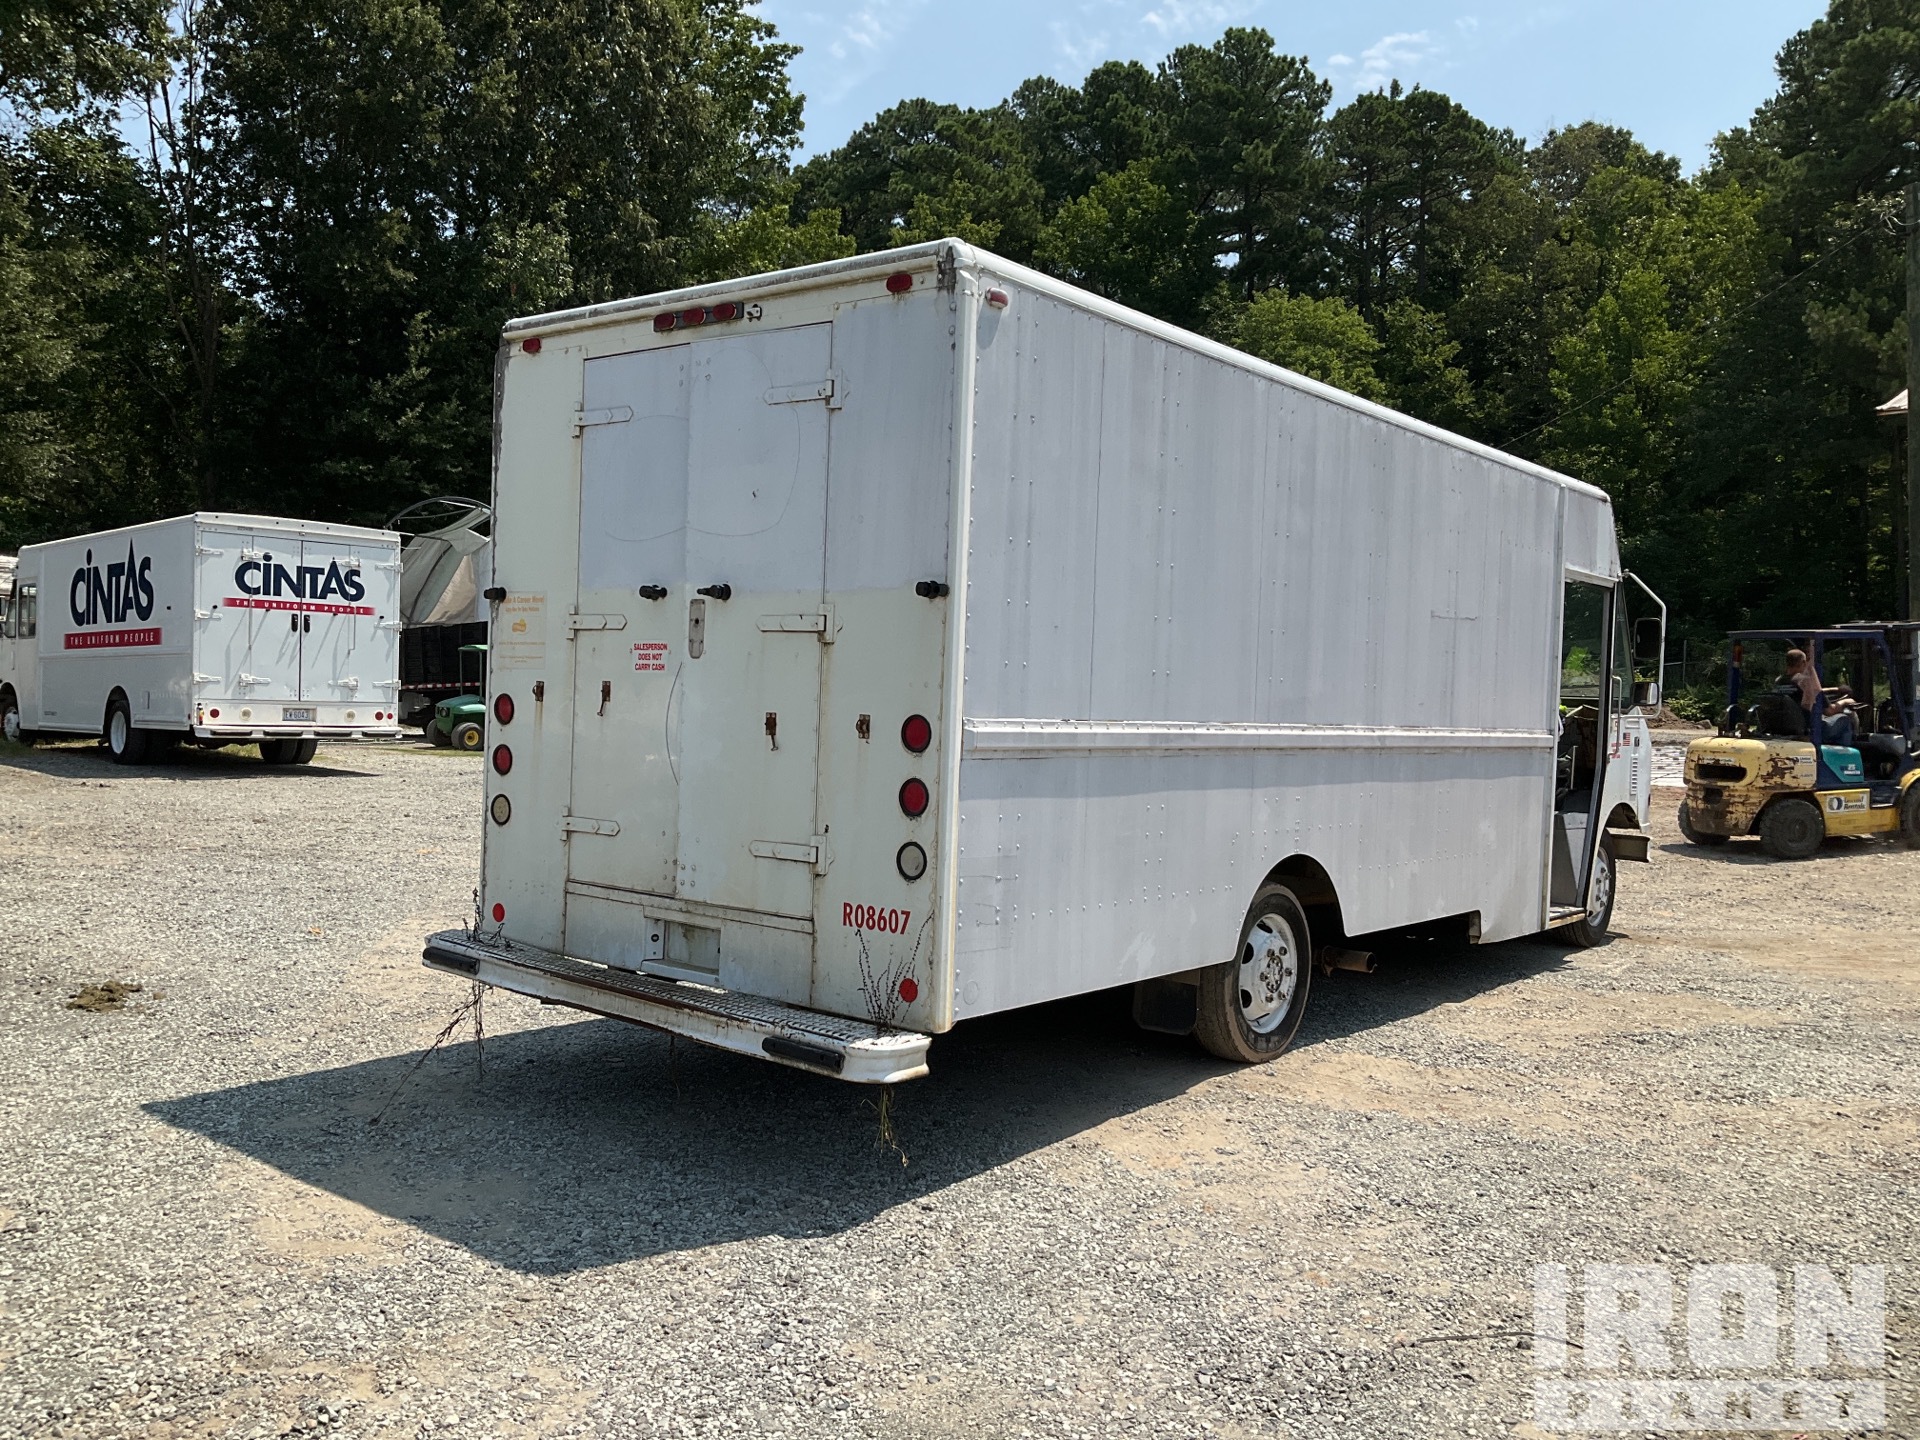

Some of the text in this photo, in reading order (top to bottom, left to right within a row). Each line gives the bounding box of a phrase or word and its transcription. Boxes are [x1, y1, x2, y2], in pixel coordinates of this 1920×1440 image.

[264, 601, 316, 611] UNIFORM
[324, 606, 364, 614] PEOPE
[70, 631, 154, 646] THE UNIFORM PEOPLE
[634, 643, 668, 651] SALESPERSON
[638, 653, 663, 661] DOES NOT
[635, 663, 666, 671] CARRY CASH
